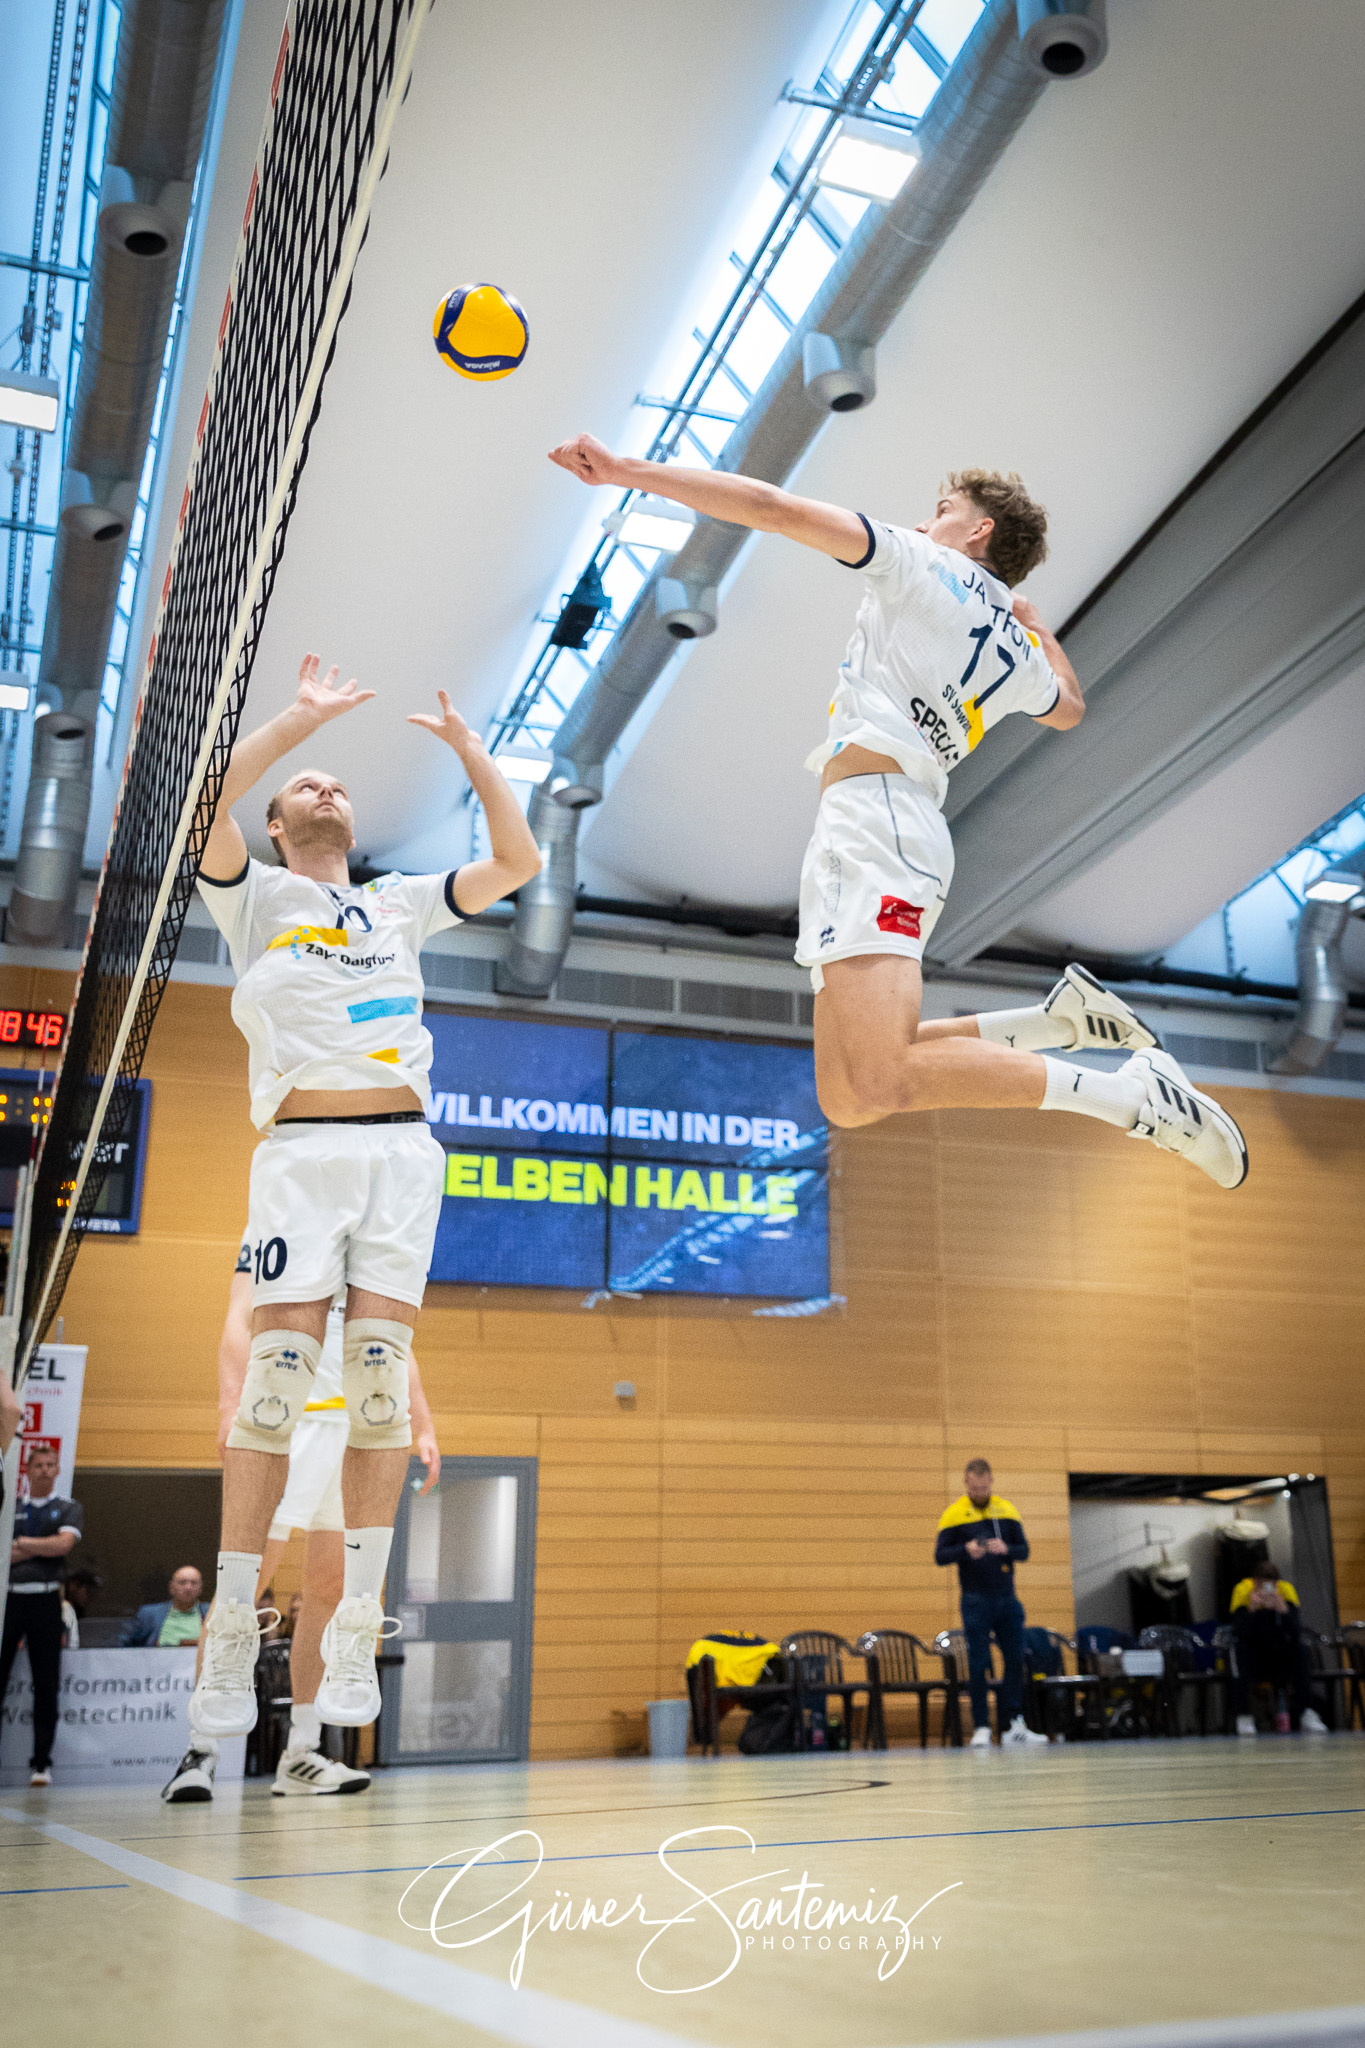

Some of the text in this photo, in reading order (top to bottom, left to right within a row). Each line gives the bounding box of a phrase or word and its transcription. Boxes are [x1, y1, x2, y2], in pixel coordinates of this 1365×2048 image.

[960, 623, 1016, 711] 17
[682, 1112, 721, 1145] IN
[724, 1115, 801, 1151] DER
[443, 1153, 799, 1218] ELBEN HALLE
[255, 1236, 288, 1285] 10
